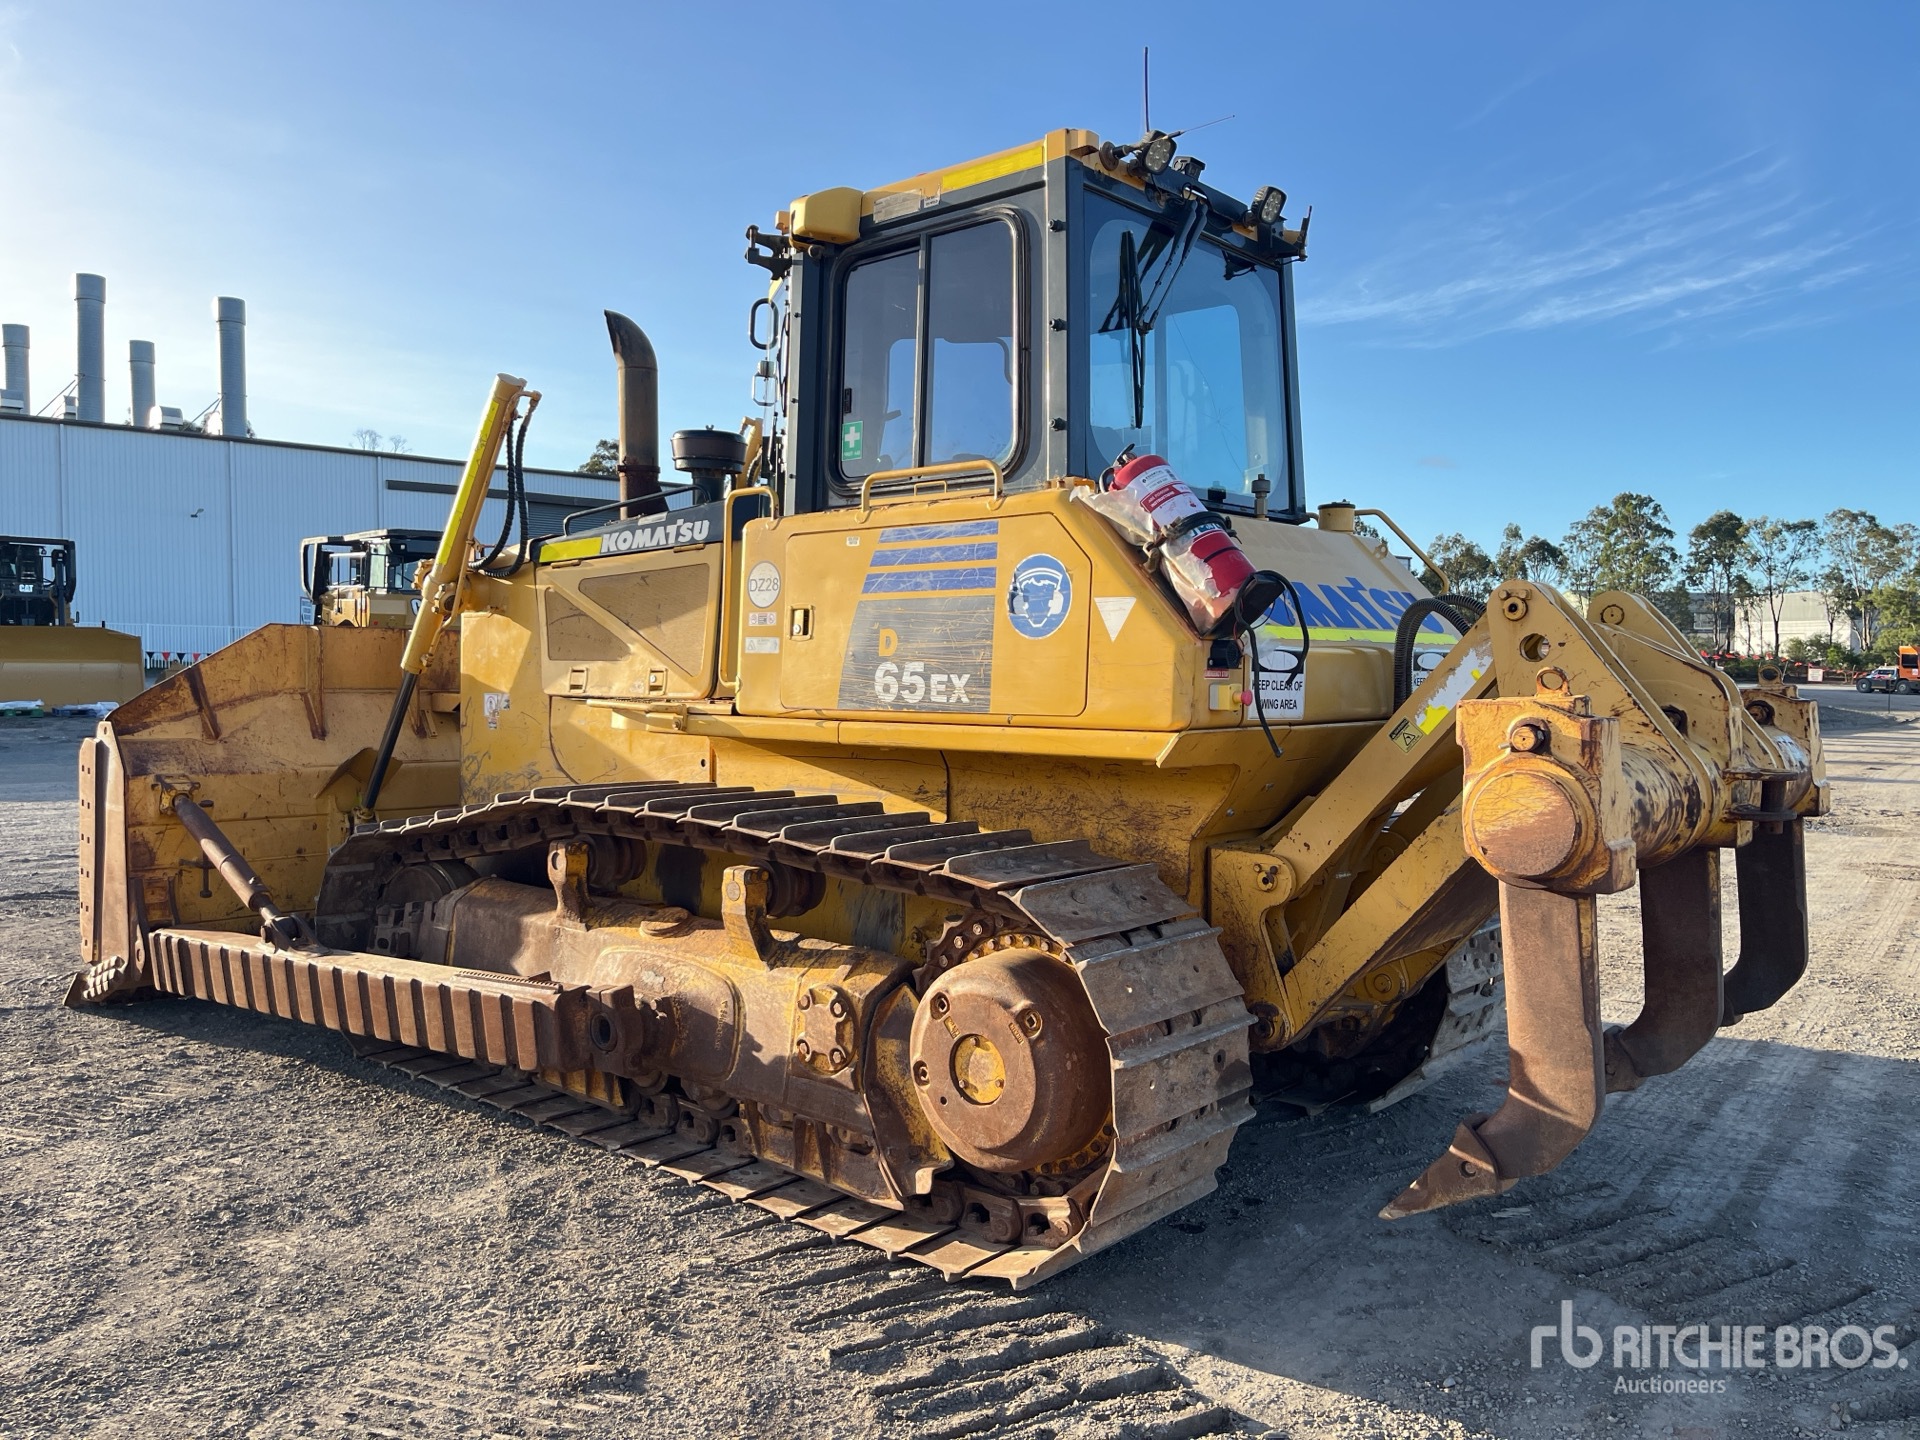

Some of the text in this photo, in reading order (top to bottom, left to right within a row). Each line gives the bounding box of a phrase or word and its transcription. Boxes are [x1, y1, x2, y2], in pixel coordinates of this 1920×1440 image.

[601, 519, 710, 553] KOMATSU
[19, 584, 34, 592] CAT
[749, 578, 779, 592] DZ28
[1263, 577, 1444, 633] OMATSU
[878, 628, 898, 656] D
[1294, 681, 1303, 691] OF
[1259, 699, 1297, 710] WING AREA
